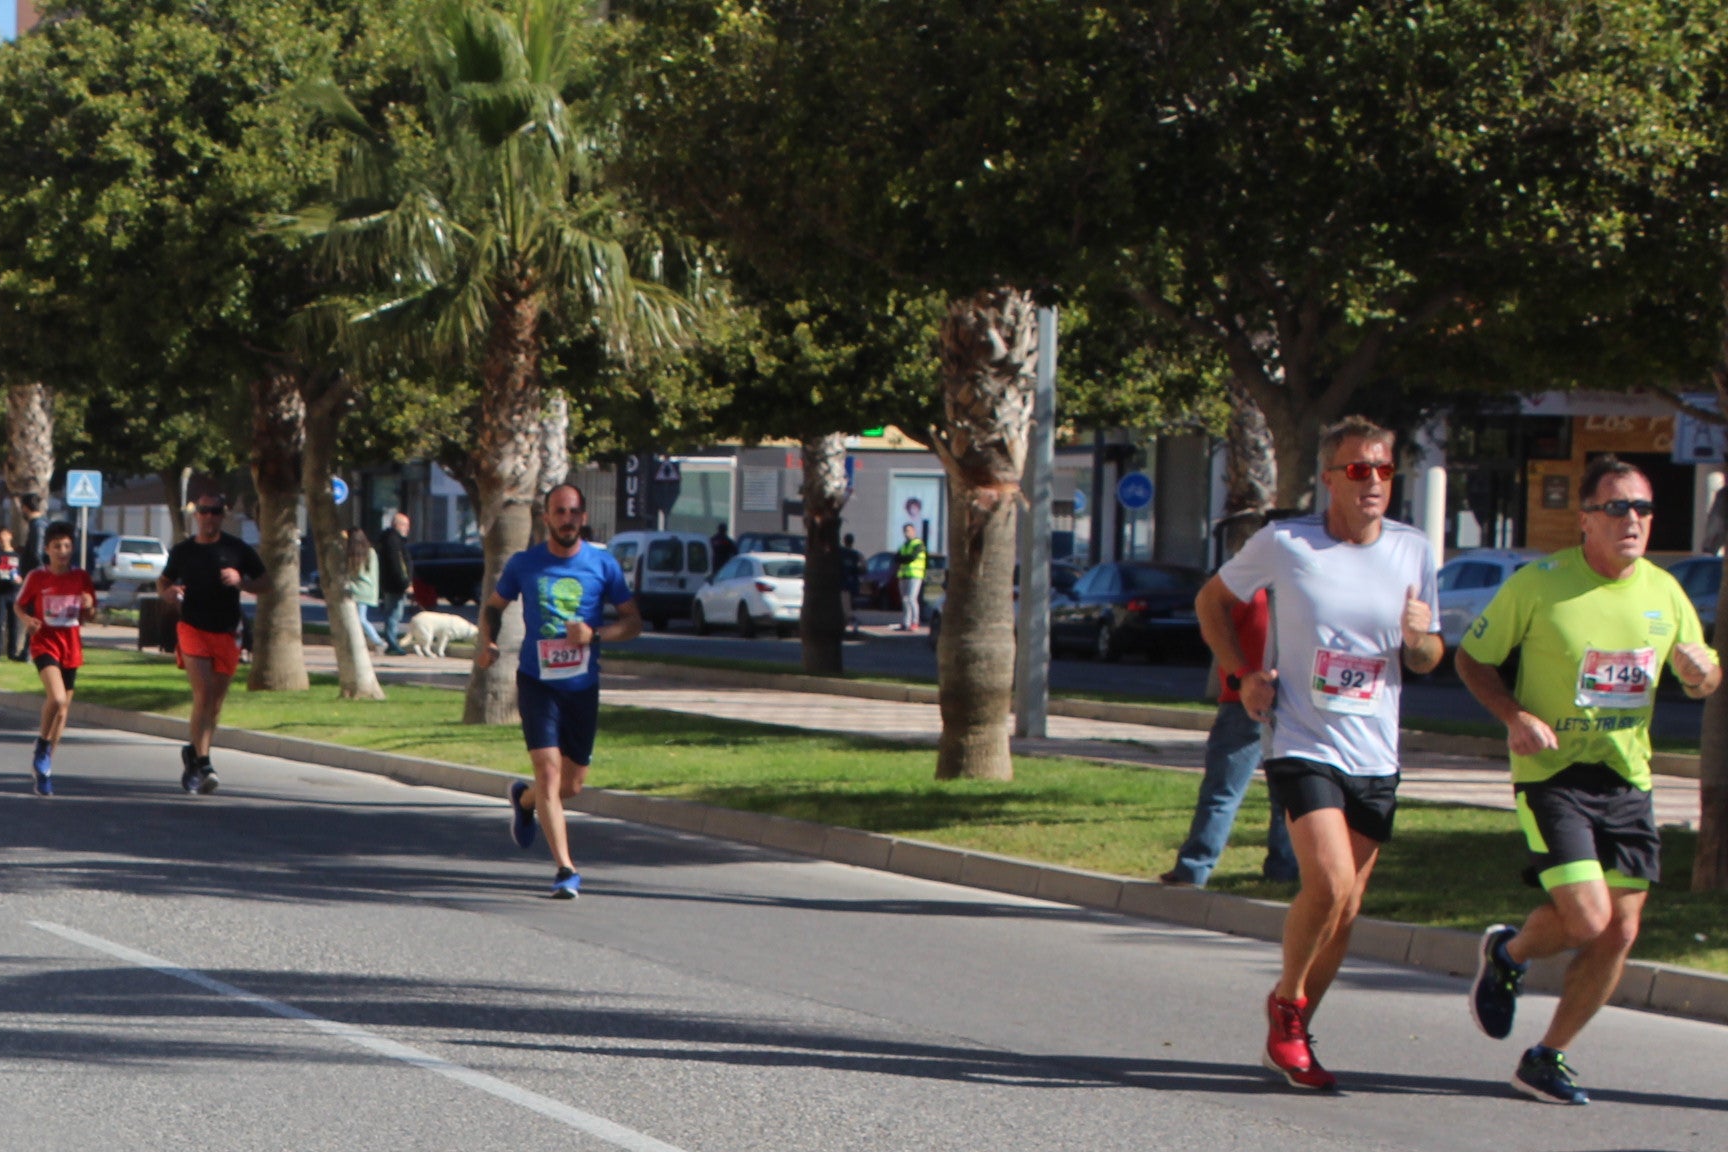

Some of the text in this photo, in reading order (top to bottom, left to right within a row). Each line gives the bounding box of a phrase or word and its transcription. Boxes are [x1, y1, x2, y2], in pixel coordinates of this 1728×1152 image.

[552, 649, 577, 663] 297
[1340, 668, 1365, 688] 92
[1605, 665, 1643, 684] 149
